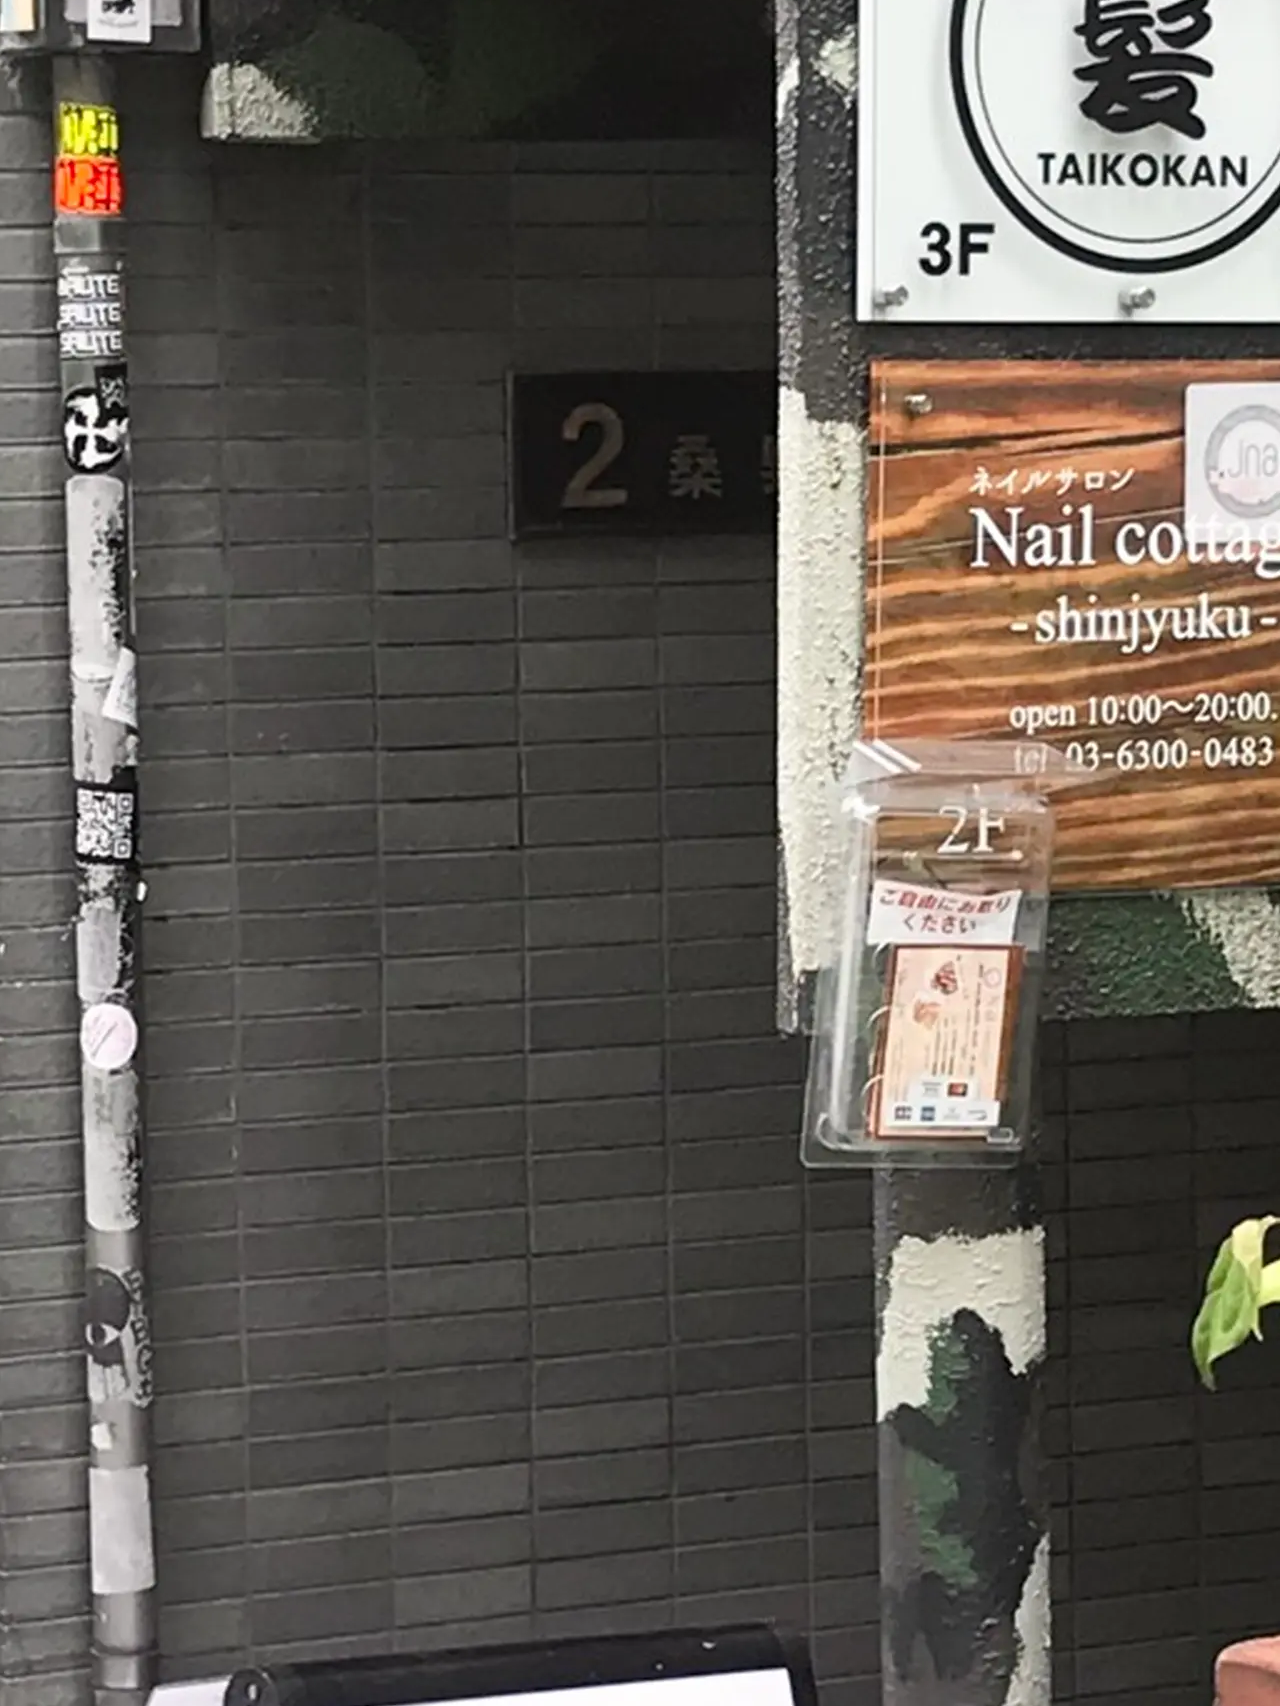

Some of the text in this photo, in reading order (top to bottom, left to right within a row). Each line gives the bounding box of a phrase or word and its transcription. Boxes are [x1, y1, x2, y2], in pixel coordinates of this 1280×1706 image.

[1037, 151, 1249, 189] TAIKOKAN
[918, 222, 996, 277] 3F
[562, 402, 778, 509] 2 桑
[969, 466, 1136, 497] ネイルサロン
[969, 502, 1097, 569] Nail
[1009, 703, 1077, 736] open
[1065, 735, 1275, 773] 03-6300-0483
[879, 888, 1011, 914] ご自由にお取り
[903, 913, 977, 934] ください
